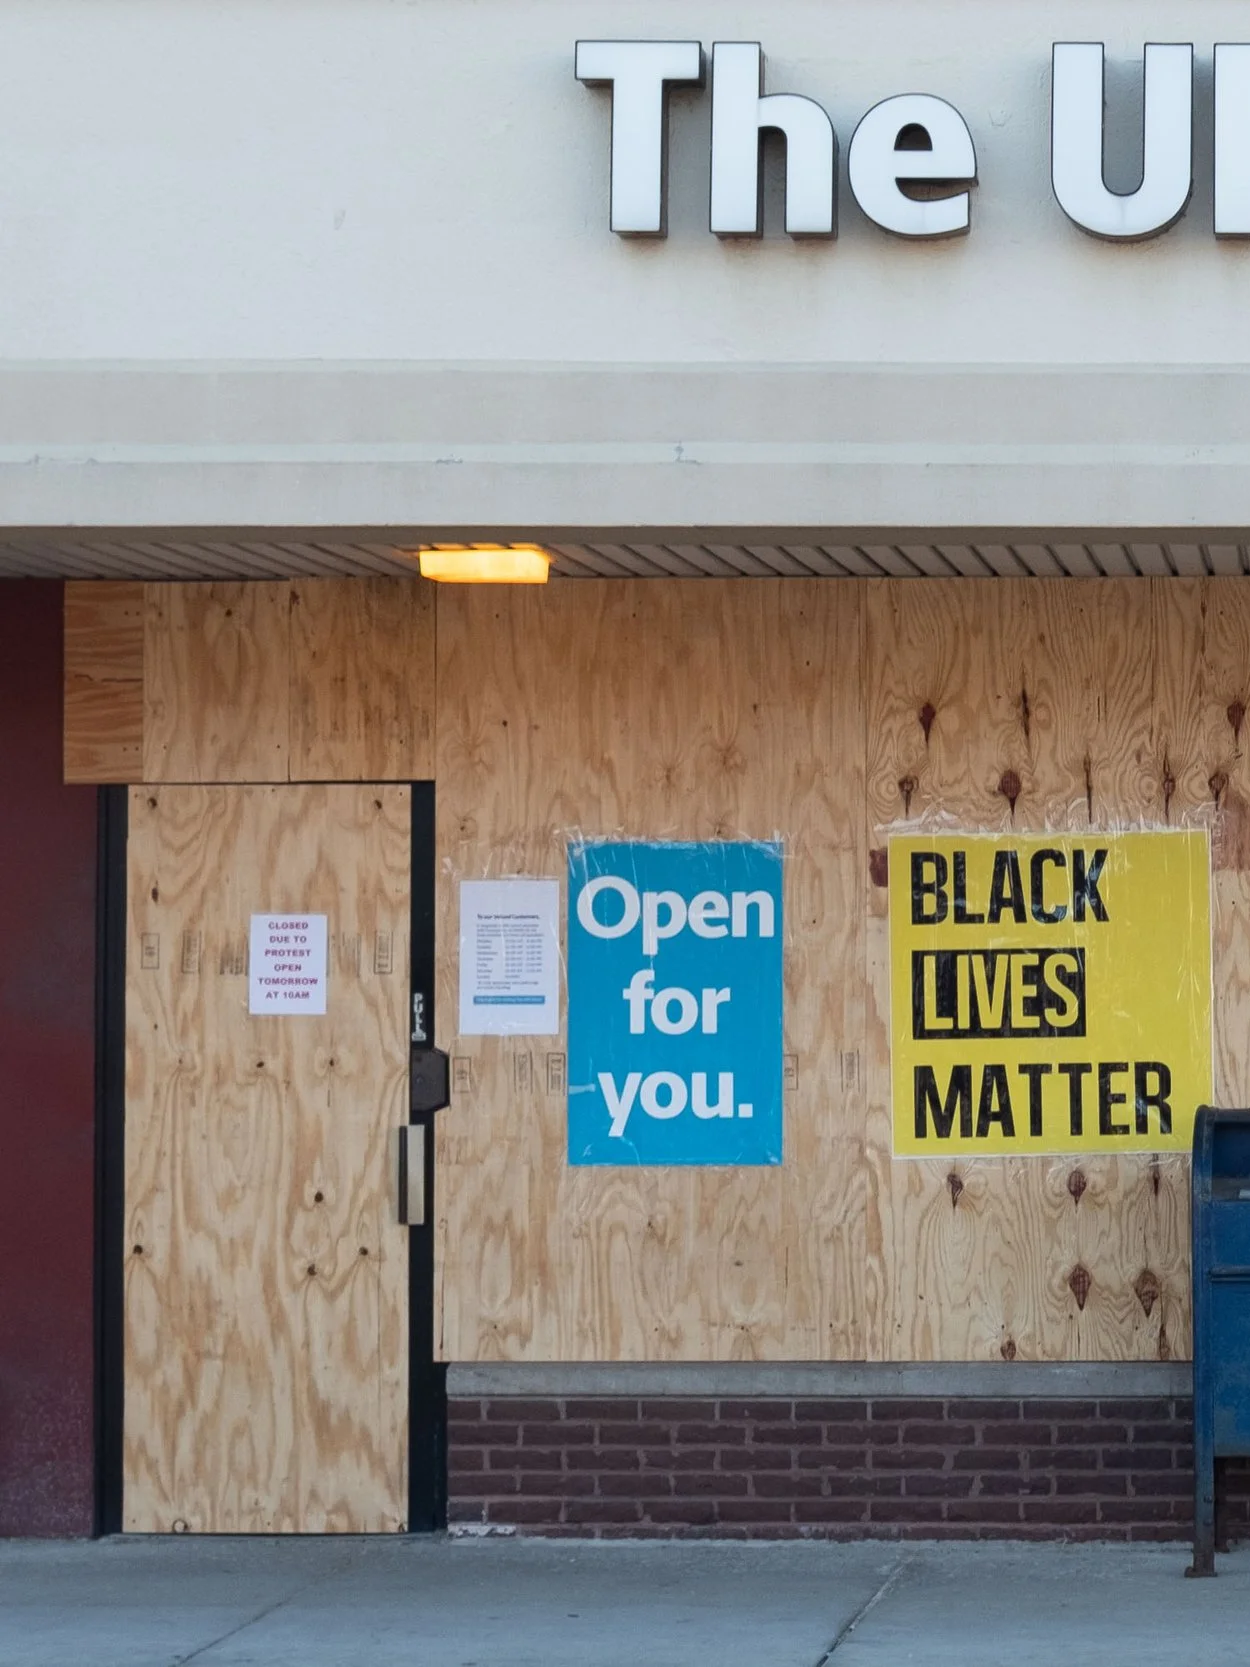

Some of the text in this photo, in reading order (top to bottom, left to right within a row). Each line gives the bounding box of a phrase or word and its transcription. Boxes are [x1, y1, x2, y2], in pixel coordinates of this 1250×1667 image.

[575, 40, 977, 238] The
[911, 848, 1109, 925] BLACK
[268, 921, 309, 930] CLOSED
[269, 935, 308, 944] DUE TO
[577, 875, 775, 956] Open
[264, 948, 312, 957] PROTEST
[273, 963, 302, 972] OPEN
[257, 977, 319, 986] TOMORROW
[265, 991, 311, 1000] AT 10AM
[622, 969, 731, 1035] for
[923, 952, 1079, 1030] LIVES
[413, 992, 424, 1031] PULL
[597, 1070, 753, 1138] you.
[913, 1061, 1173, 1139] MATTER
